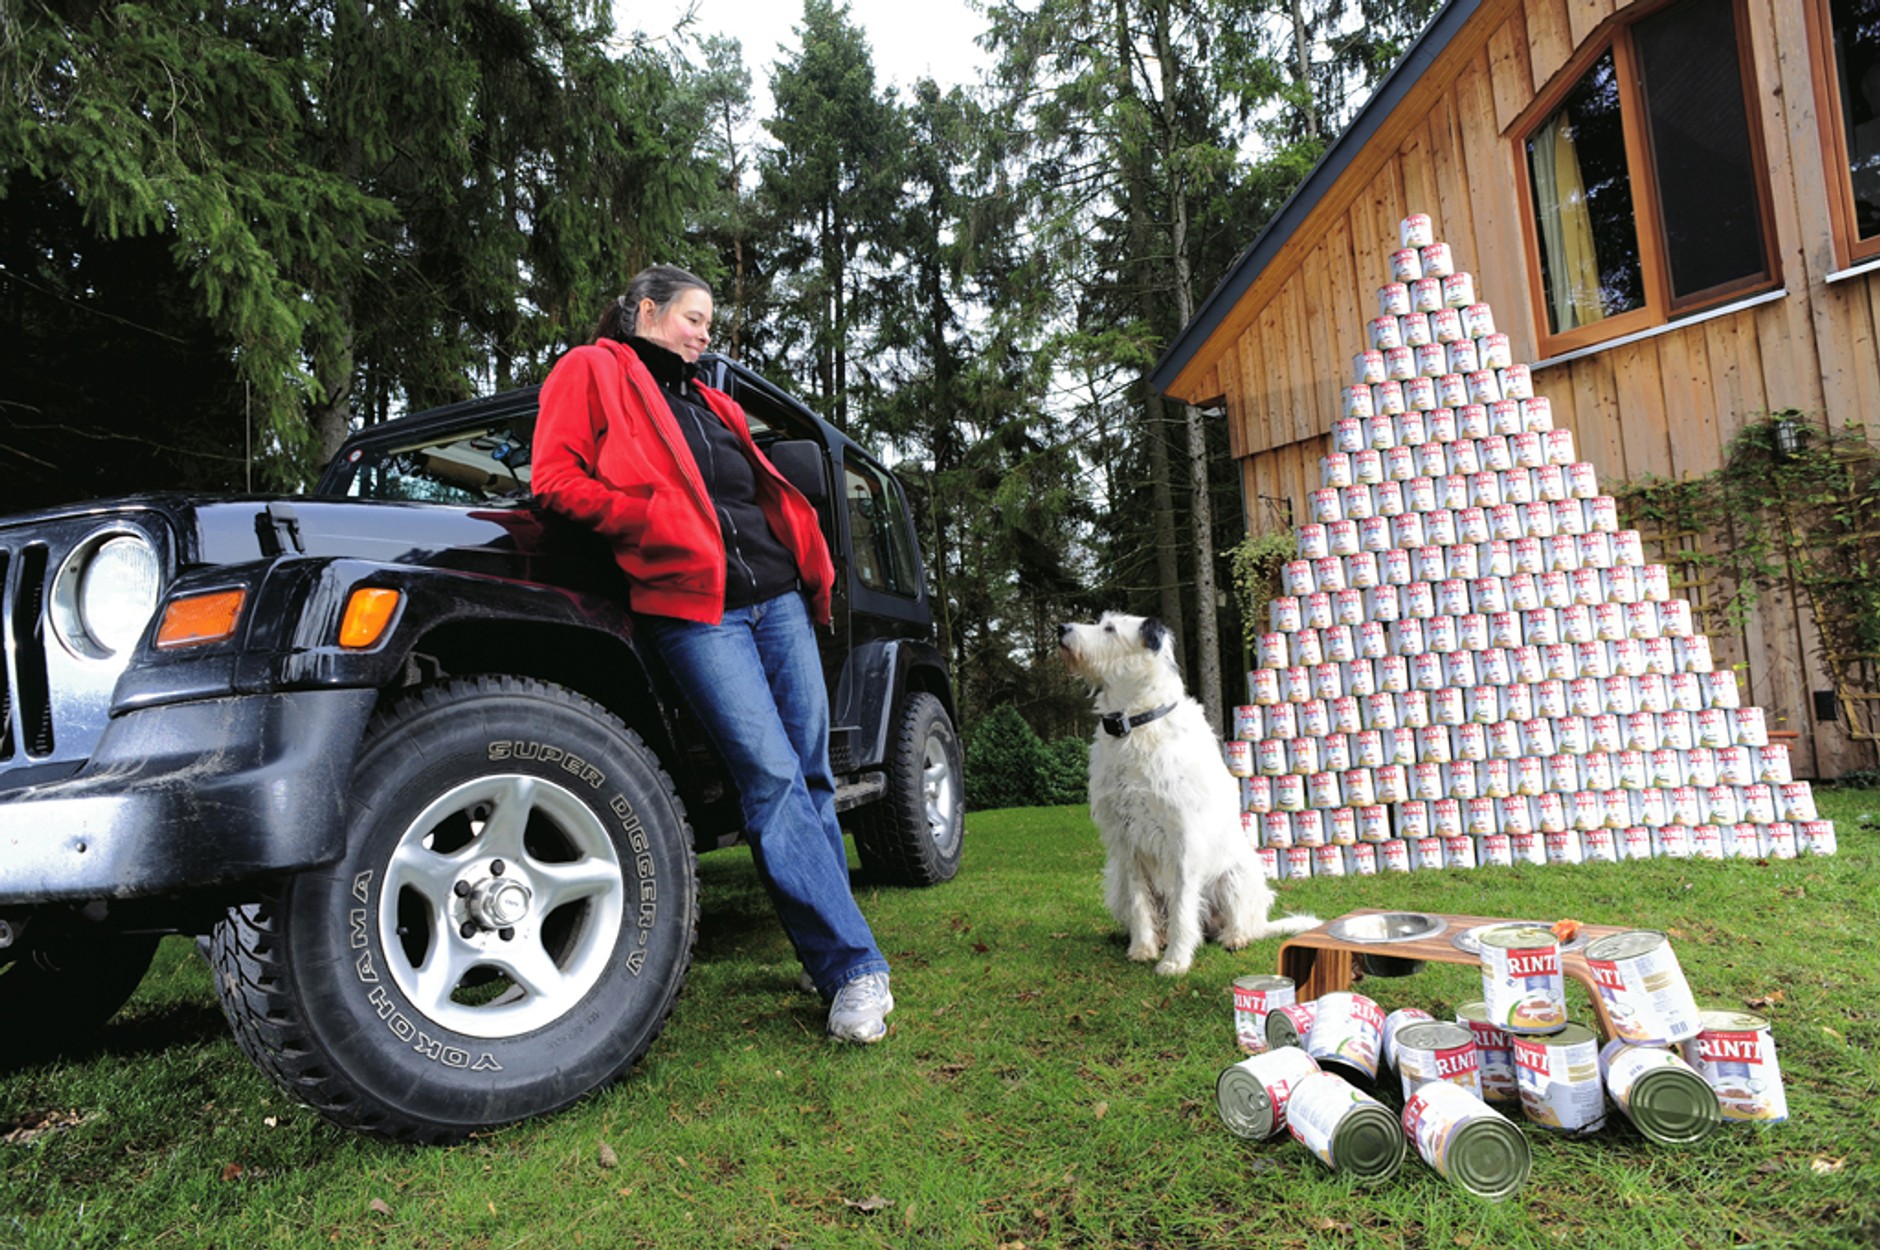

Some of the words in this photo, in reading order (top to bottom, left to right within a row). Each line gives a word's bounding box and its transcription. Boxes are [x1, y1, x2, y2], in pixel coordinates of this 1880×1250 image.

[488, 741, 605, 788] SUPER
[350, 869, 502, 1071] YOKOHAMA
[1507, 955, 1558, 974] RINTI
[1590, 966, 1625, 987] NTI
[1235, 993, 1267, 1013] INTI
[1472, 1029, 1513, 1048] RINT
[1696, 1038, 1762, 1059] RINTI
[1514, 1044, 1550, 1072] INTI
[1406, 1098, 1428, 1144] INTI
